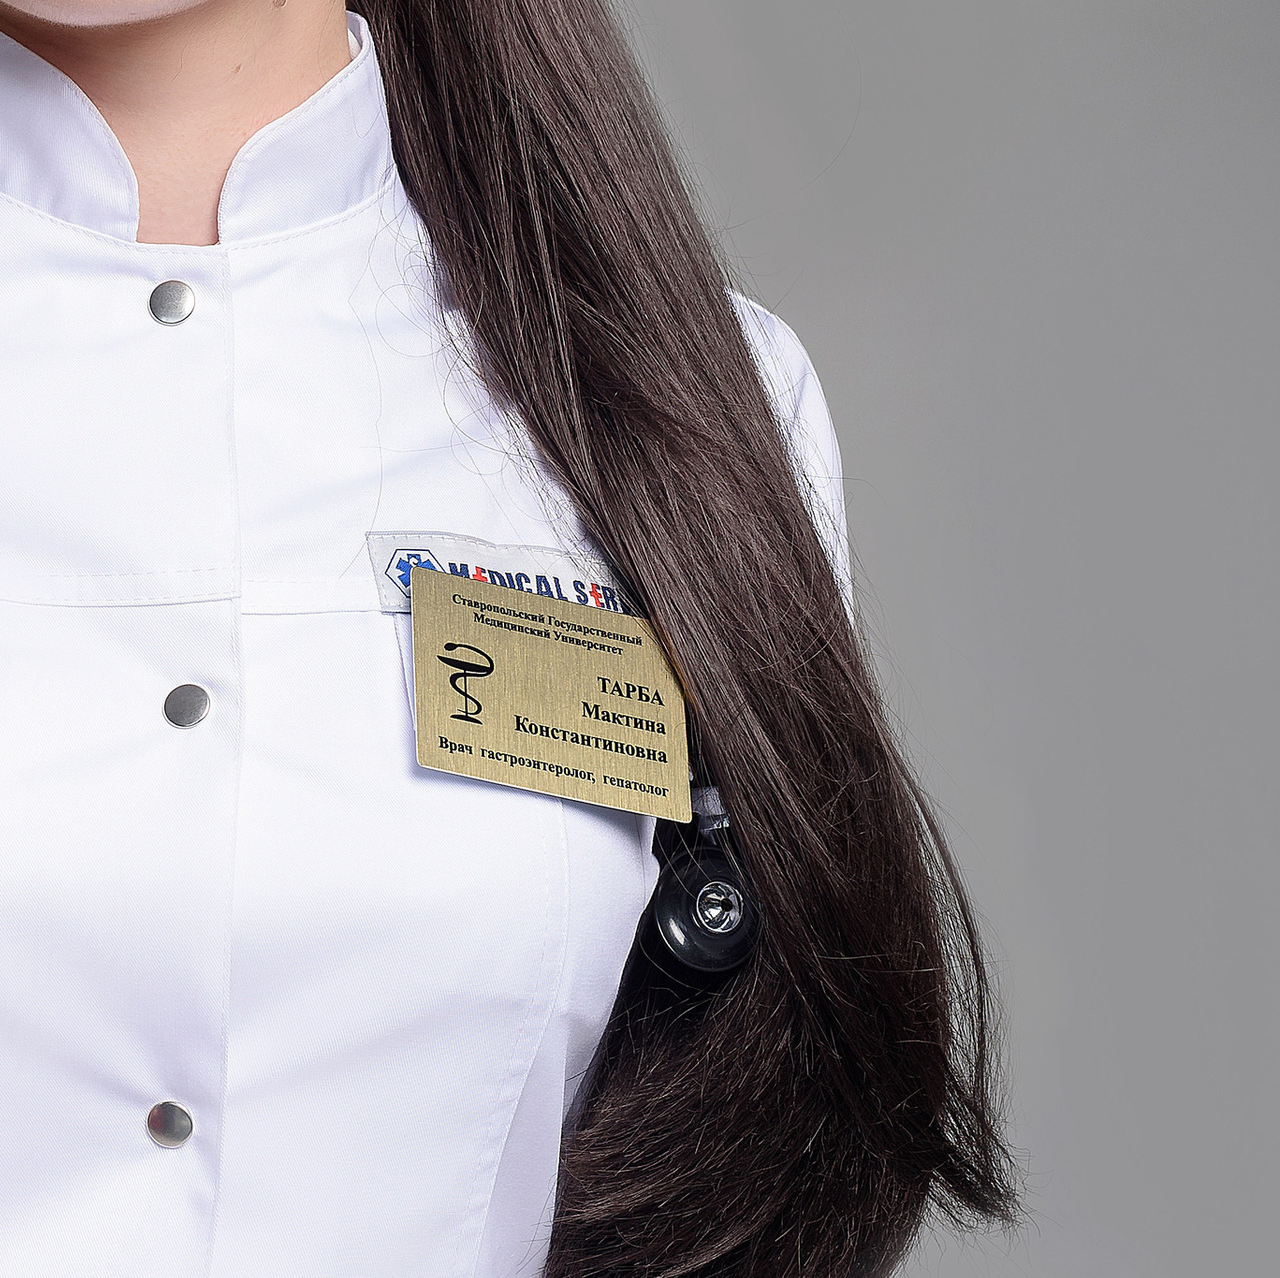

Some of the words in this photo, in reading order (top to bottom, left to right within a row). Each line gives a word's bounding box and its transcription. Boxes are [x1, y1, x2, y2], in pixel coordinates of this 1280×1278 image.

[573, 579, 624, 613] SER
[452, 593, 545, 624] Ставропольский
[548, 615, 643, 646] Государственный
[473, 612, 551, 639] Медицинский
[553, 630, 623, 656] Университет
[597, 676, 665, 707] ТАРБА
[514, 714, 669, 764] Константиновна
[581, 700, 667, 735] Мактина
[438, 735, 473, 755] Врач
[481, 747, 596, 784] гастроэнтеролог,
[603, 774, 670, 798] гепатолог
